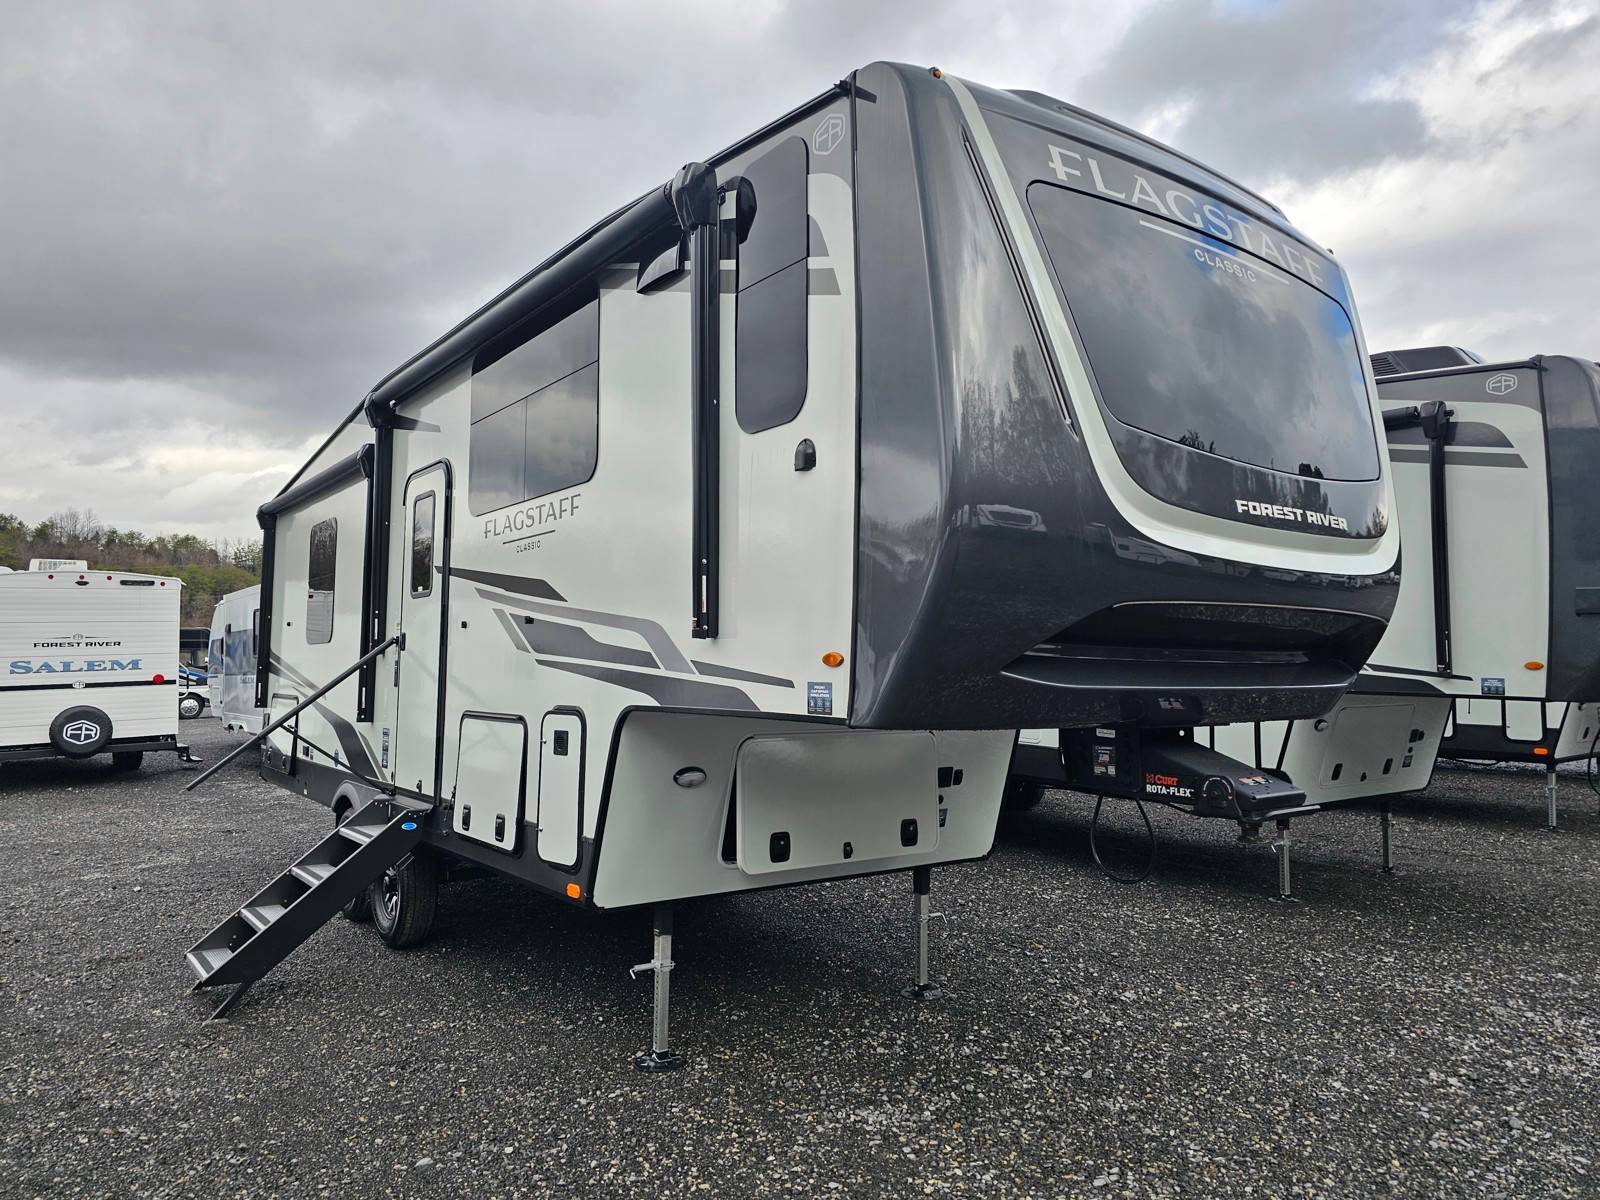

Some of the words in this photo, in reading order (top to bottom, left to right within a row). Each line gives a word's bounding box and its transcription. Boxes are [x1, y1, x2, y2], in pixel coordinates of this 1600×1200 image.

[1047, 143, 1323, 285] FLAGSTAFF
[1194, 248, 1257, 282] CLASSIC
[483, 493, 581, 539] FLAGSTAFF
[1235, 499, 1304, 522] FOREST
[1305, 510, 1349, 531] RIVER
[515, 540, 541, 553] CLASSIC
[9, 658, 143, 675] SALEM
[1146, 784, 1191, 797] ROTA-FLEX
[1155, 774, 1178, 786] CURT
